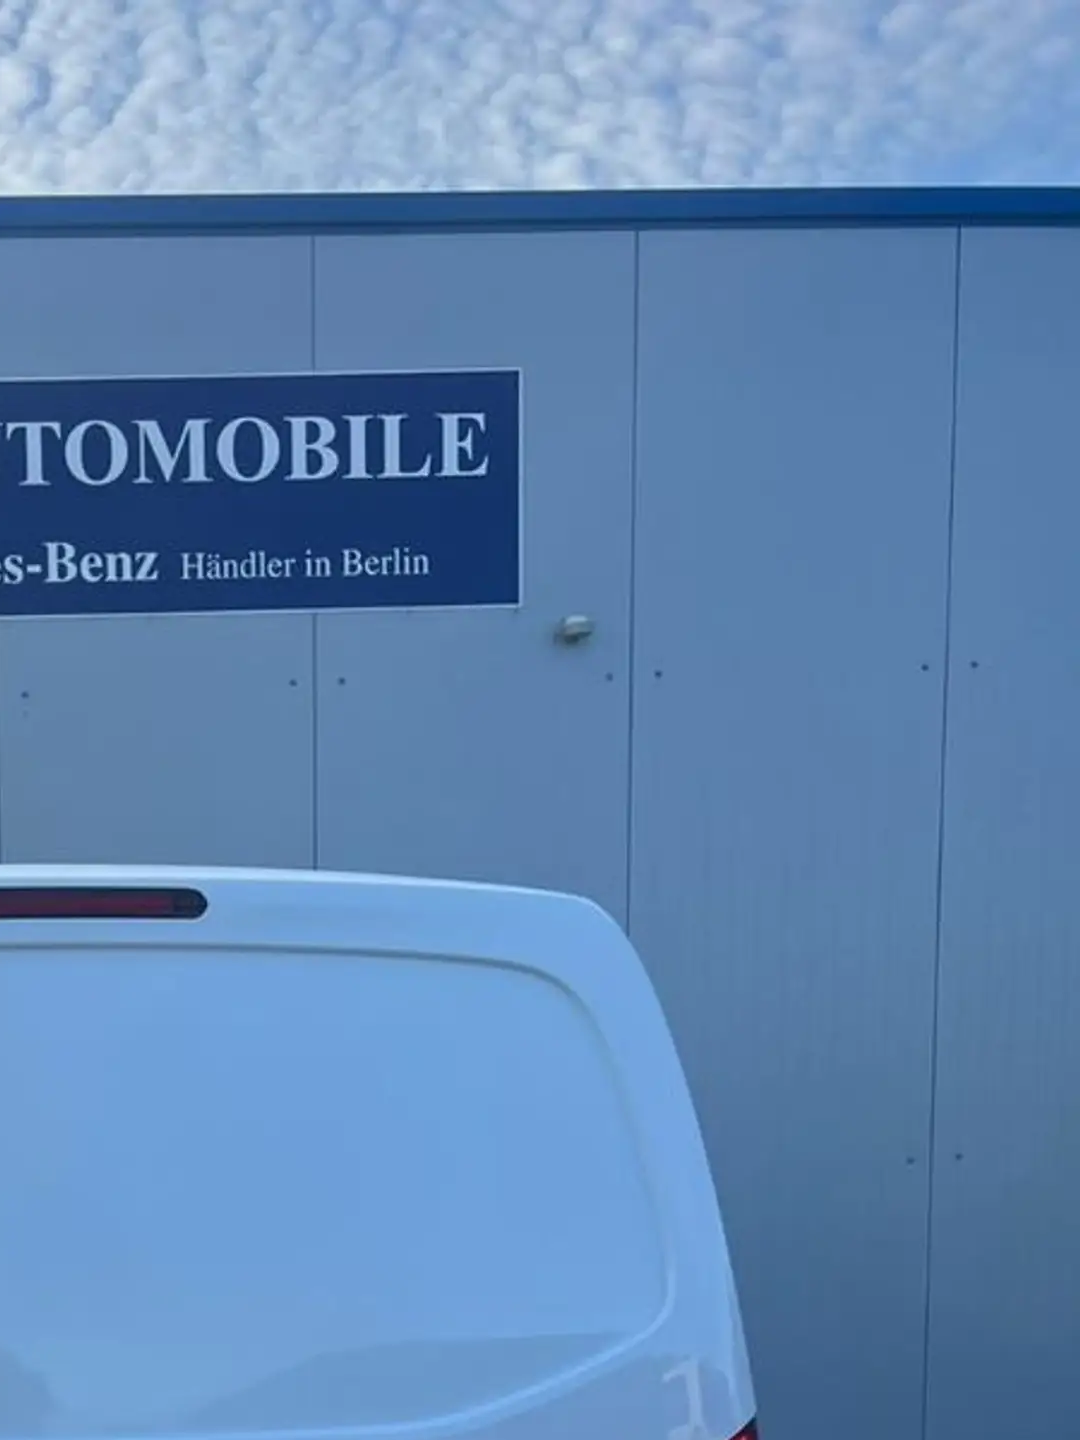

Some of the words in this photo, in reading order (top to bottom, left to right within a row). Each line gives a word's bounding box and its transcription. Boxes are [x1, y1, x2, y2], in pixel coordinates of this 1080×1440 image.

[180, 549, 296, 580] Händler
[304, 548, 331, 577] in
[342, 547, 430, 577] Berlin
